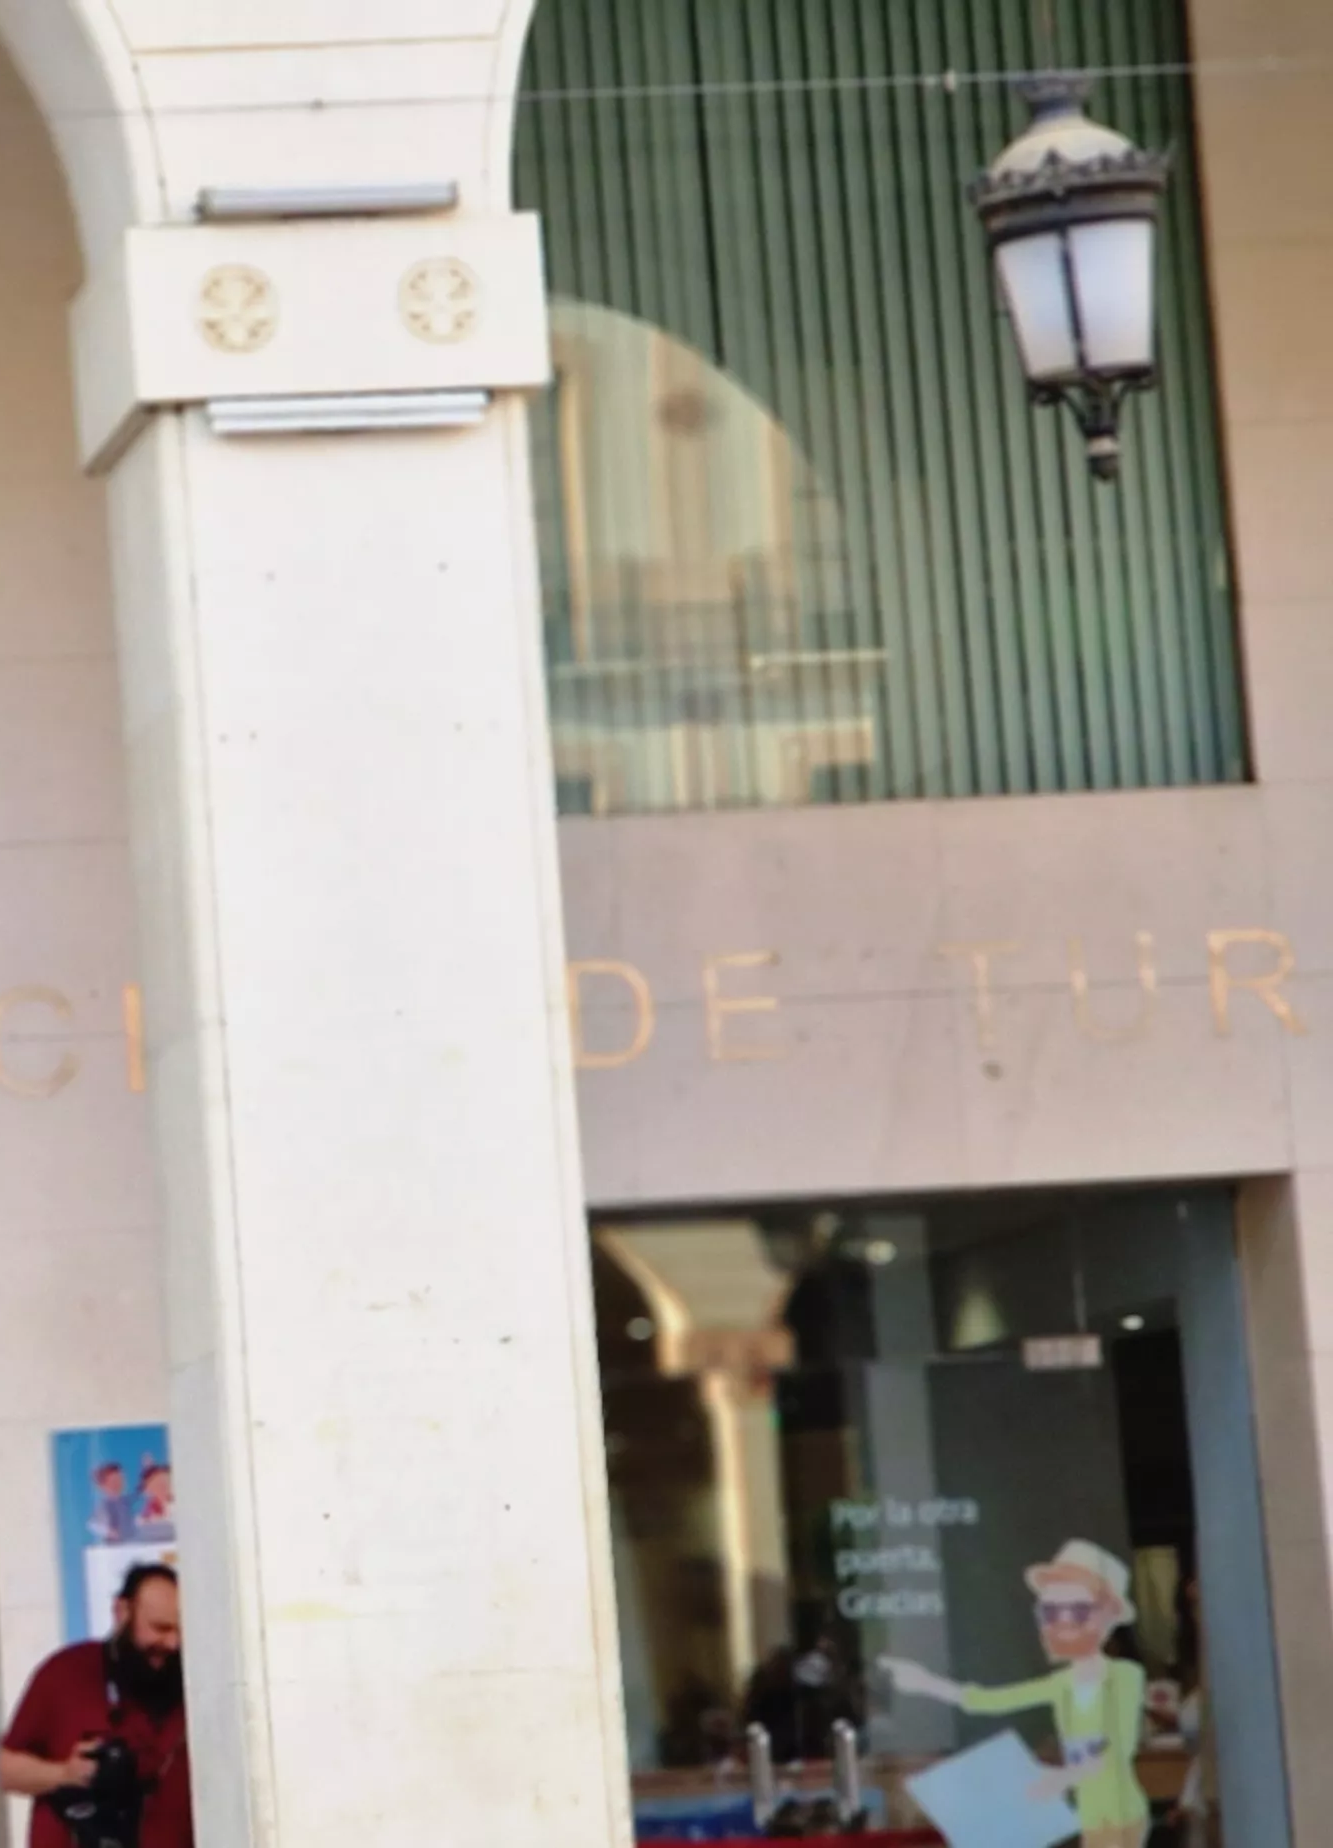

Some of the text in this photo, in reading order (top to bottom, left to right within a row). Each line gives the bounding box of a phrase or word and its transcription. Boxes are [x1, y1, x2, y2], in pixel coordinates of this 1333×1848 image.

[566, 950, 786, 1070] DE
[831, 1495, 979, 1529] Por la otra
[838, 1588, 945, 1619] Gracias
